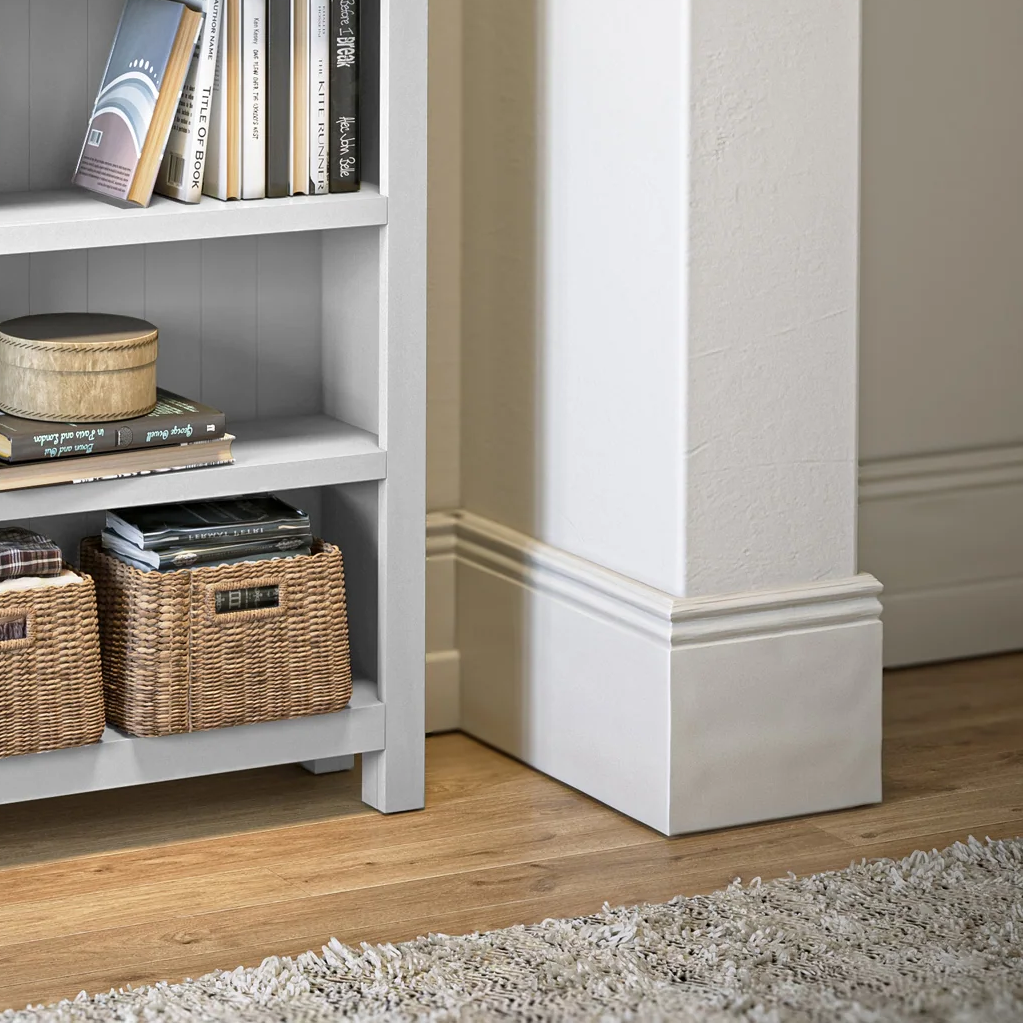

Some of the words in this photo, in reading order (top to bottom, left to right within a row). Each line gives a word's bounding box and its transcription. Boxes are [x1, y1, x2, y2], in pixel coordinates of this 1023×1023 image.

[252, 29, 260, 45] Kesey
[339, 28, 354, 36] I
[207, 35, 215, 61] NAME
[337, 37, 355, 68] Break
[199, 86, 212, 123] TITLE
[197, 127, 206, 148] OF
[340, 133, 355, 155] John
[192, 150, 204, 189] BOOK
[340, 157, 355, 178] Belle
[76, 430, 96, 441] Paris
[145, 428, 168, 442] Orwell
[171, 424, 193, 437] George
[34, 433, 59, 446] London
[61, 433, 74, 444] and
[58, 445, 72, 457] and
[75, 443, 94, 454] Down
